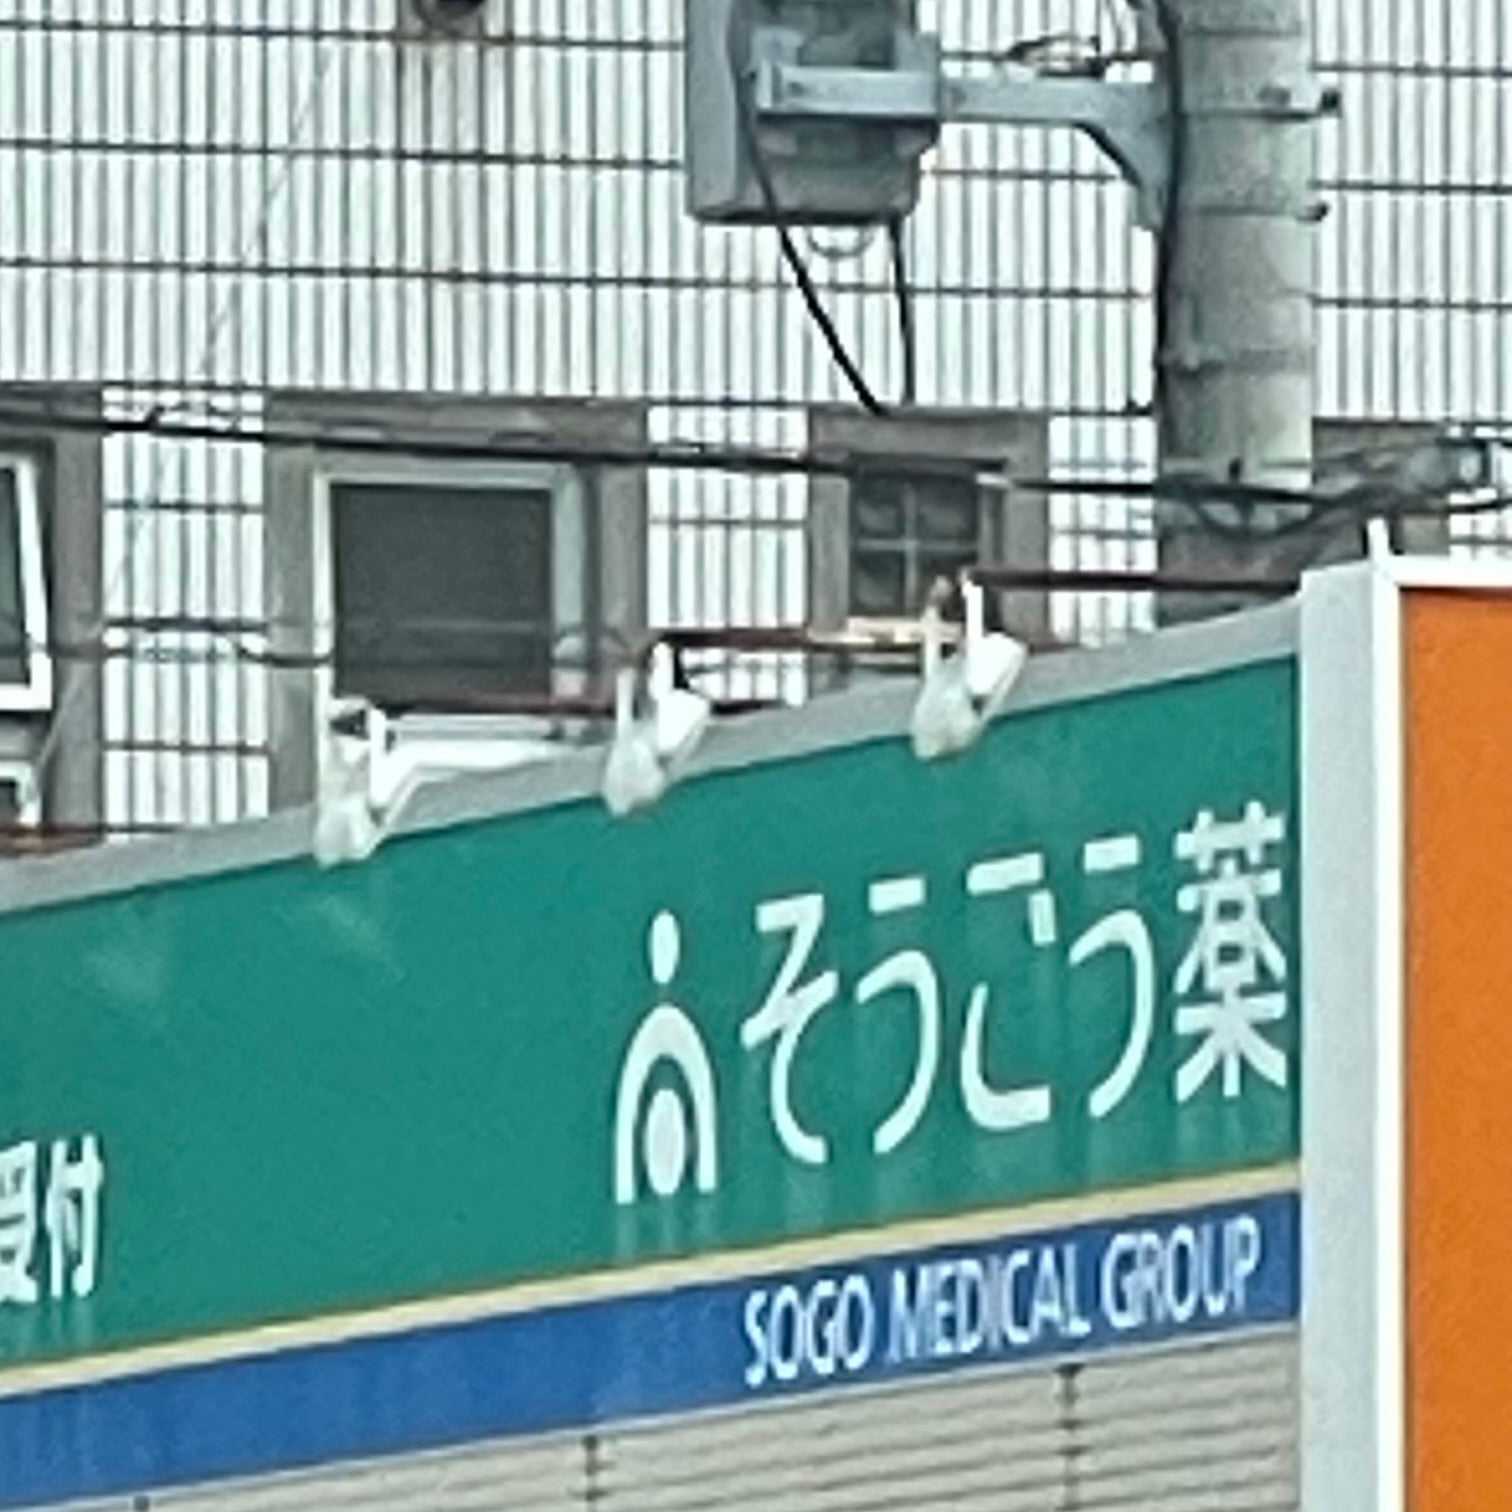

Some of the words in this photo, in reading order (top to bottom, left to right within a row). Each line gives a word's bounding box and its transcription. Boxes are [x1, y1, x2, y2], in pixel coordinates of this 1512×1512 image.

[740, 801, 1287, 1163] そうごう薬
[743, 1273, 874, 1388] SOGO
[888, 1243, 1093, 1362] MEDICAL
[1100, 1214, 1261, 1330] GROUP
